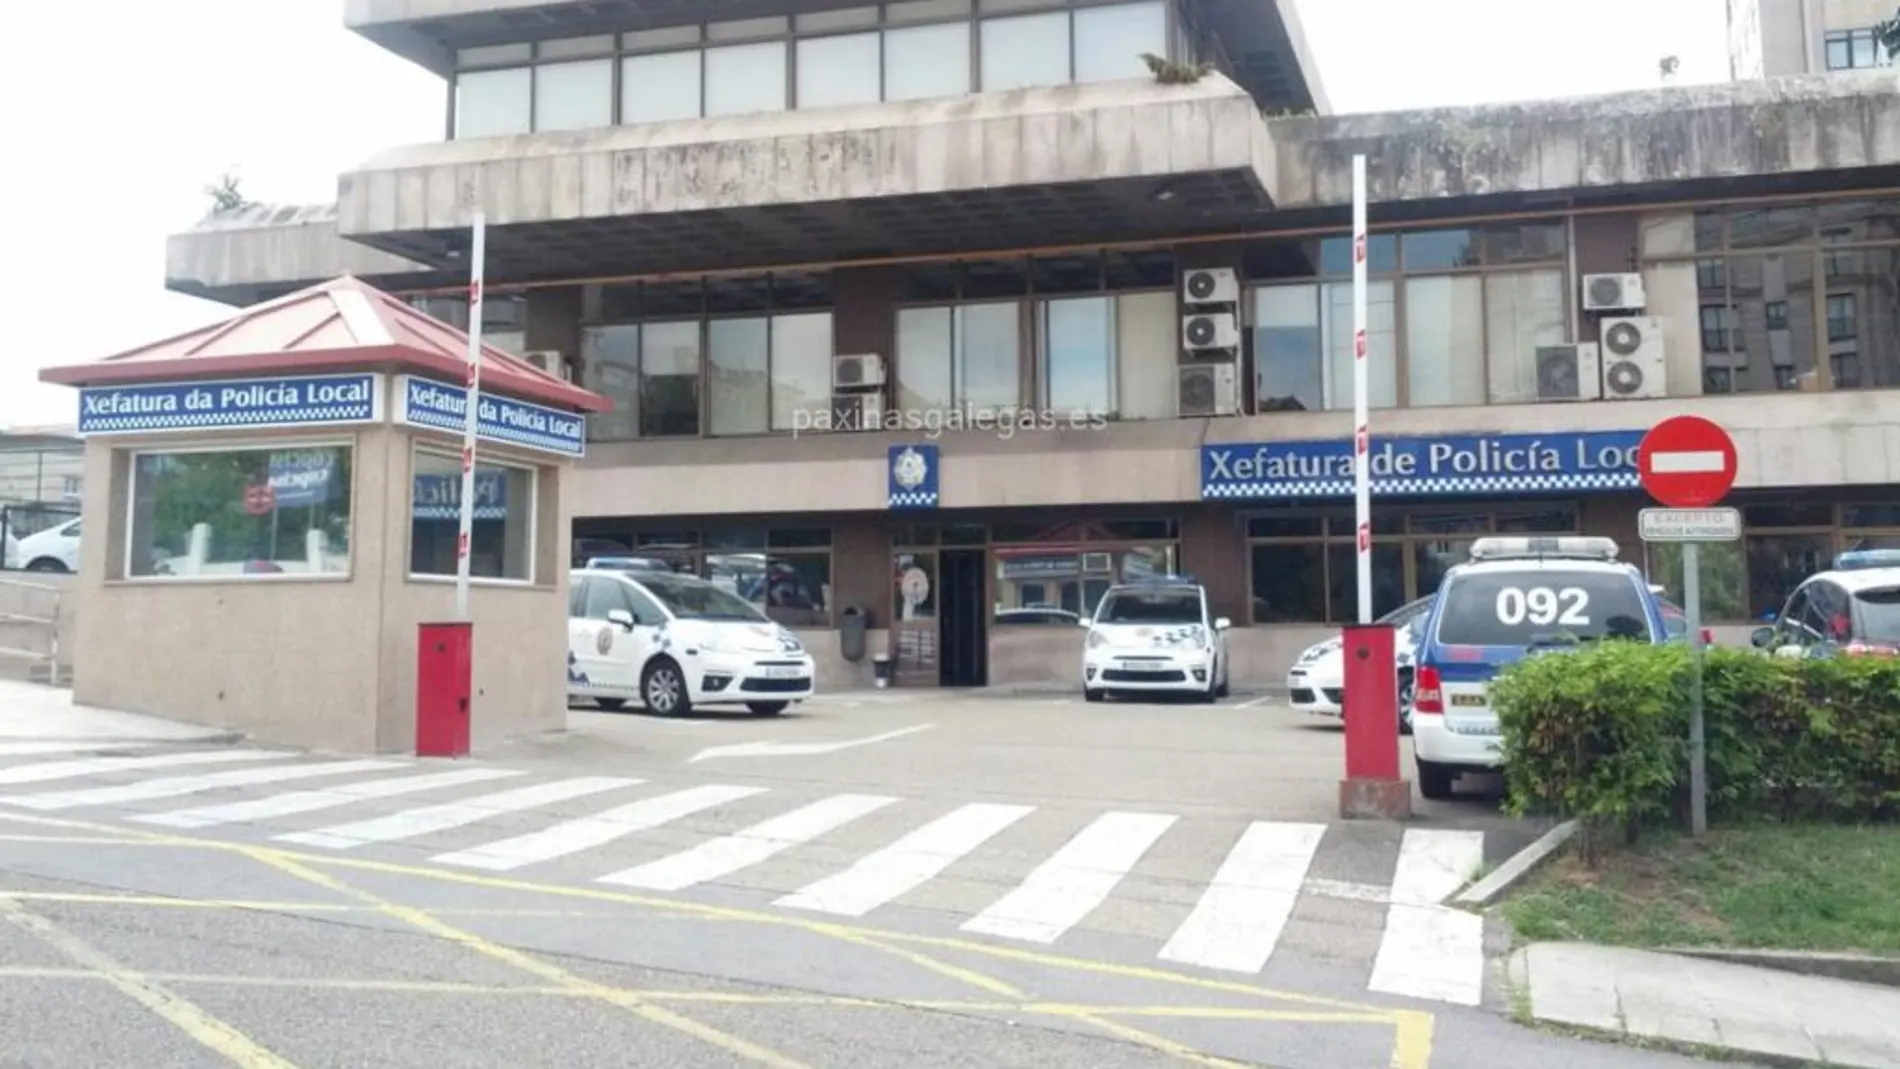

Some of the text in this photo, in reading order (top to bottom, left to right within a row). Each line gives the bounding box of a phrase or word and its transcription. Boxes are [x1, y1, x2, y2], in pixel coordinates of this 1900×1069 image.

[84, 379, 369, 414] Xefatura da Policía Local
[409, 385, 581, 438] Xefatur da Policía Local
[1209, 446, 1356, 480] Xefatura
[1371, 442, 1415, 474] de
[1430, 439, 1560, 473] Policía
[1496, 586, 1590, 625] 092
